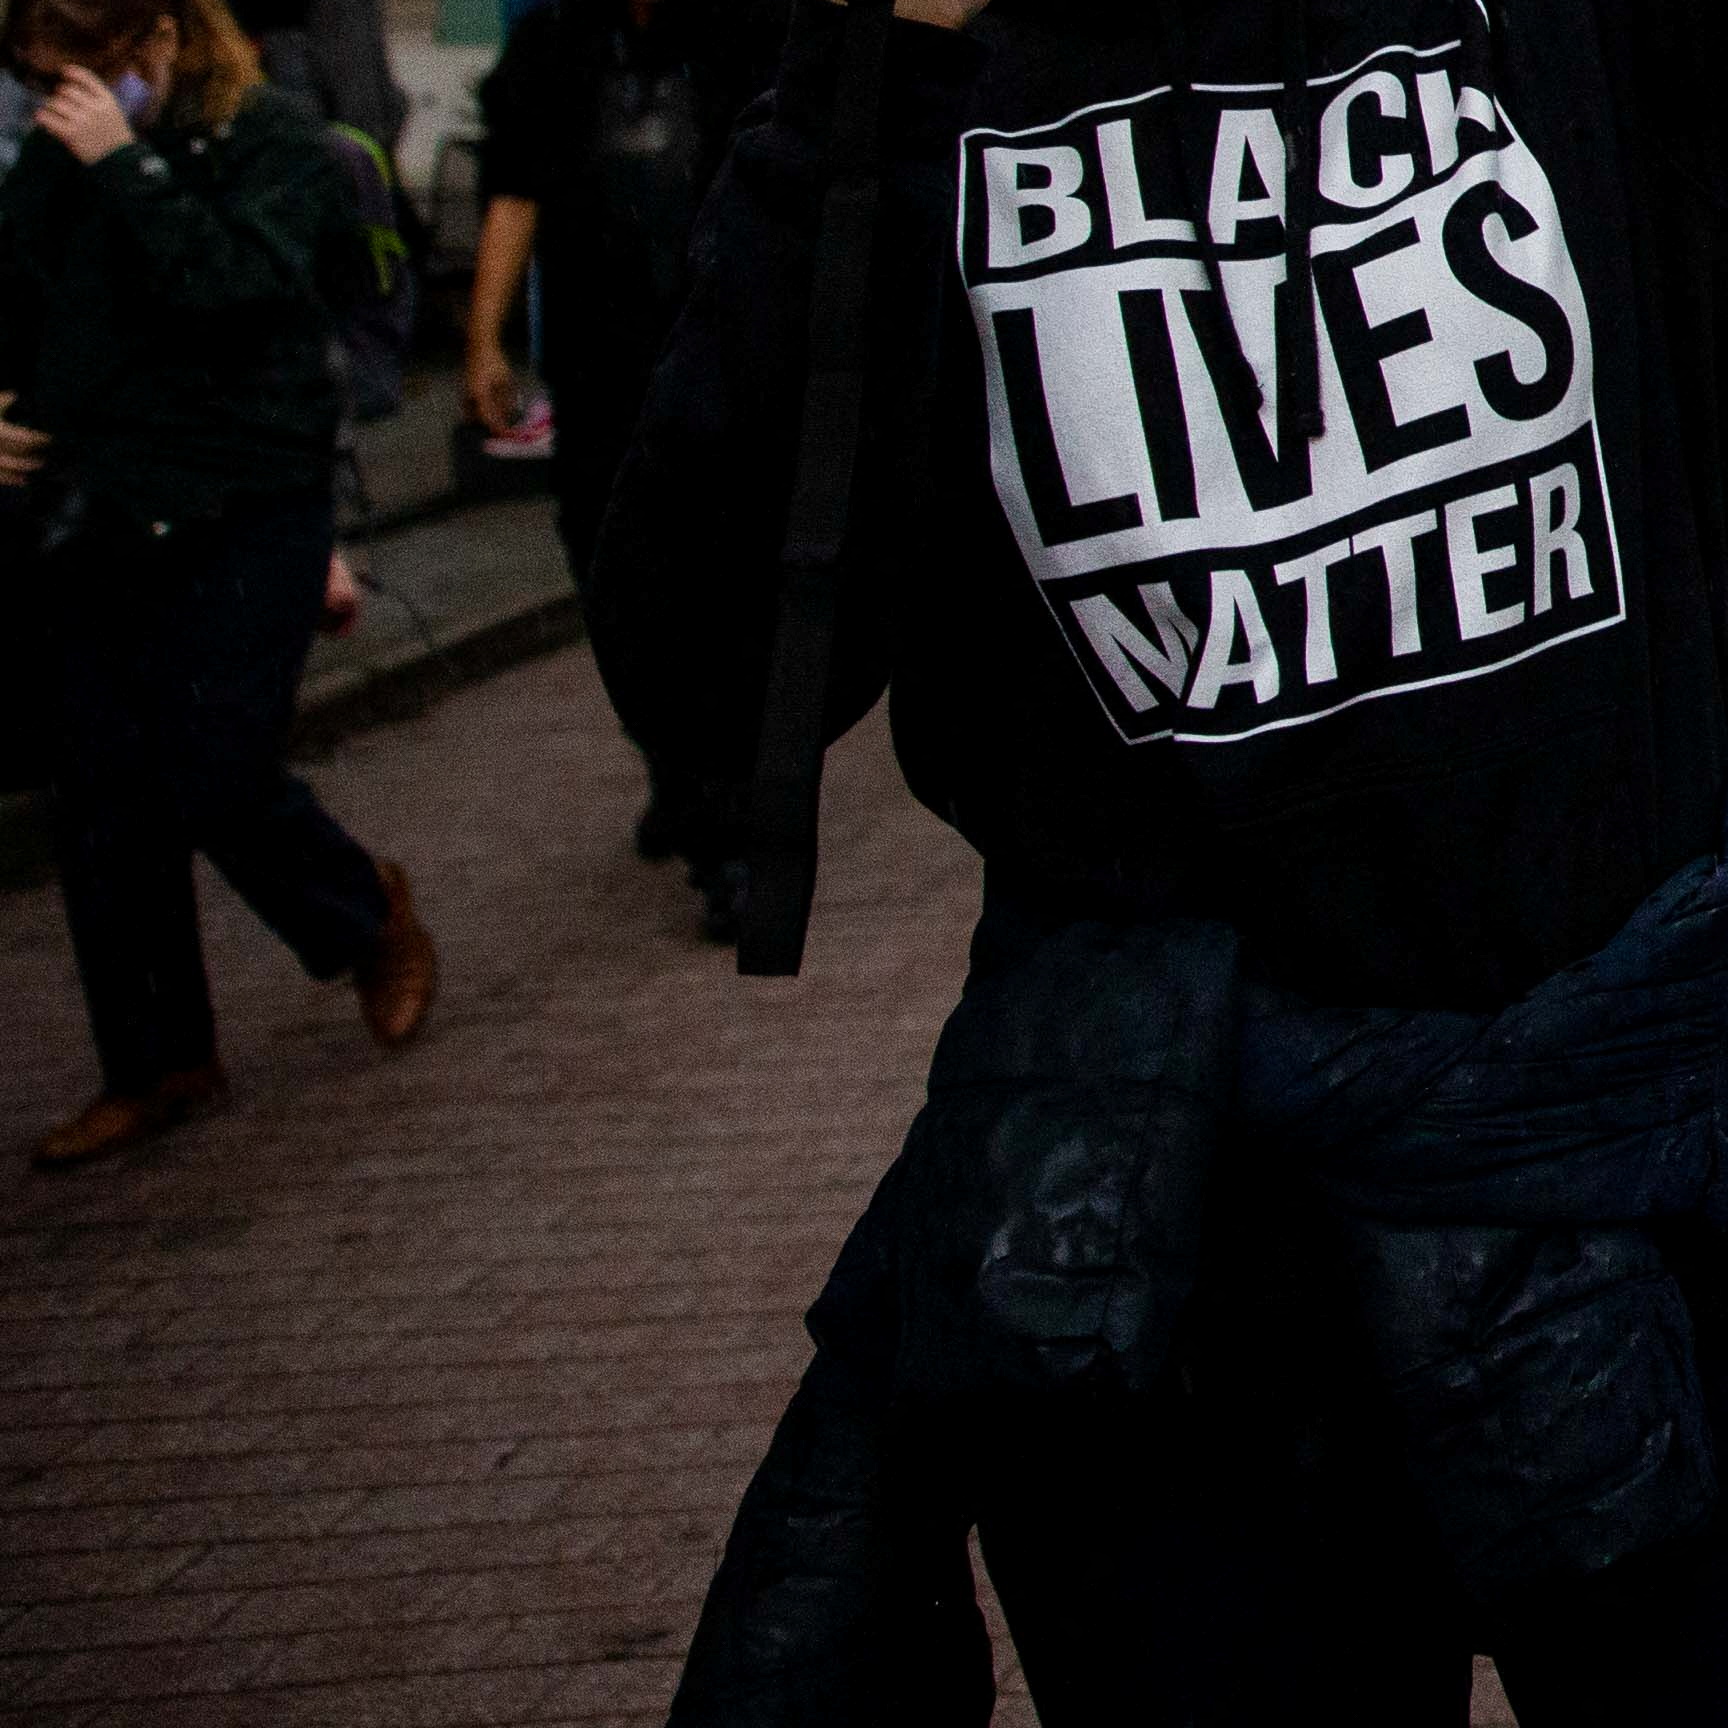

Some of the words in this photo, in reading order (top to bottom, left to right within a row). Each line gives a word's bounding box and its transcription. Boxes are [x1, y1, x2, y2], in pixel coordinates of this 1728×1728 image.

[982, 68, 1498, 270] BLACK
[992, 178, 1576, 550] LIVES
[1068, 461, 1596, 716] MATTER
